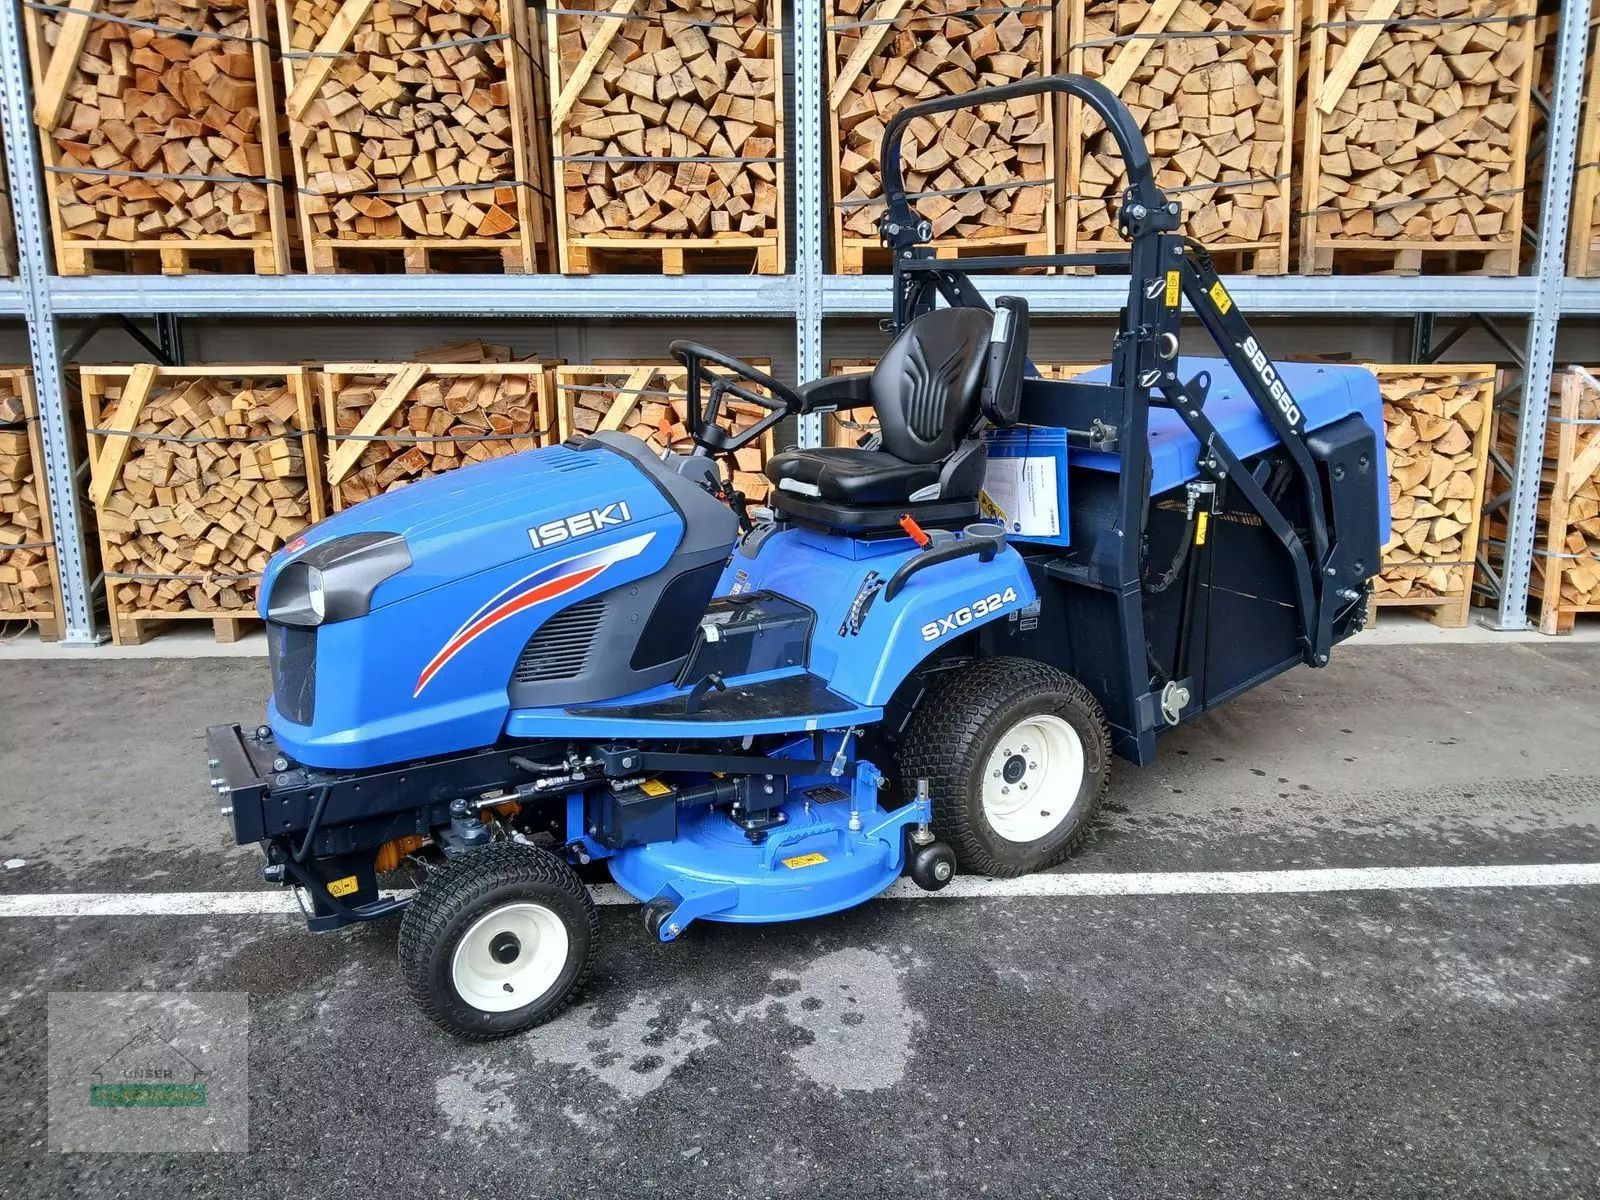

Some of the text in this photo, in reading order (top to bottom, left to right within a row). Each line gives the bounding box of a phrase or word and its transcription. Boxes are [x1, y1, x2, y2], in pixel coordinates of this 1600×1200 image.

[1242, 336, 1301, 426] SBC650
[527, 500, 632, 550] ISEKI
[921, 586, 1017, 642] SXG324
